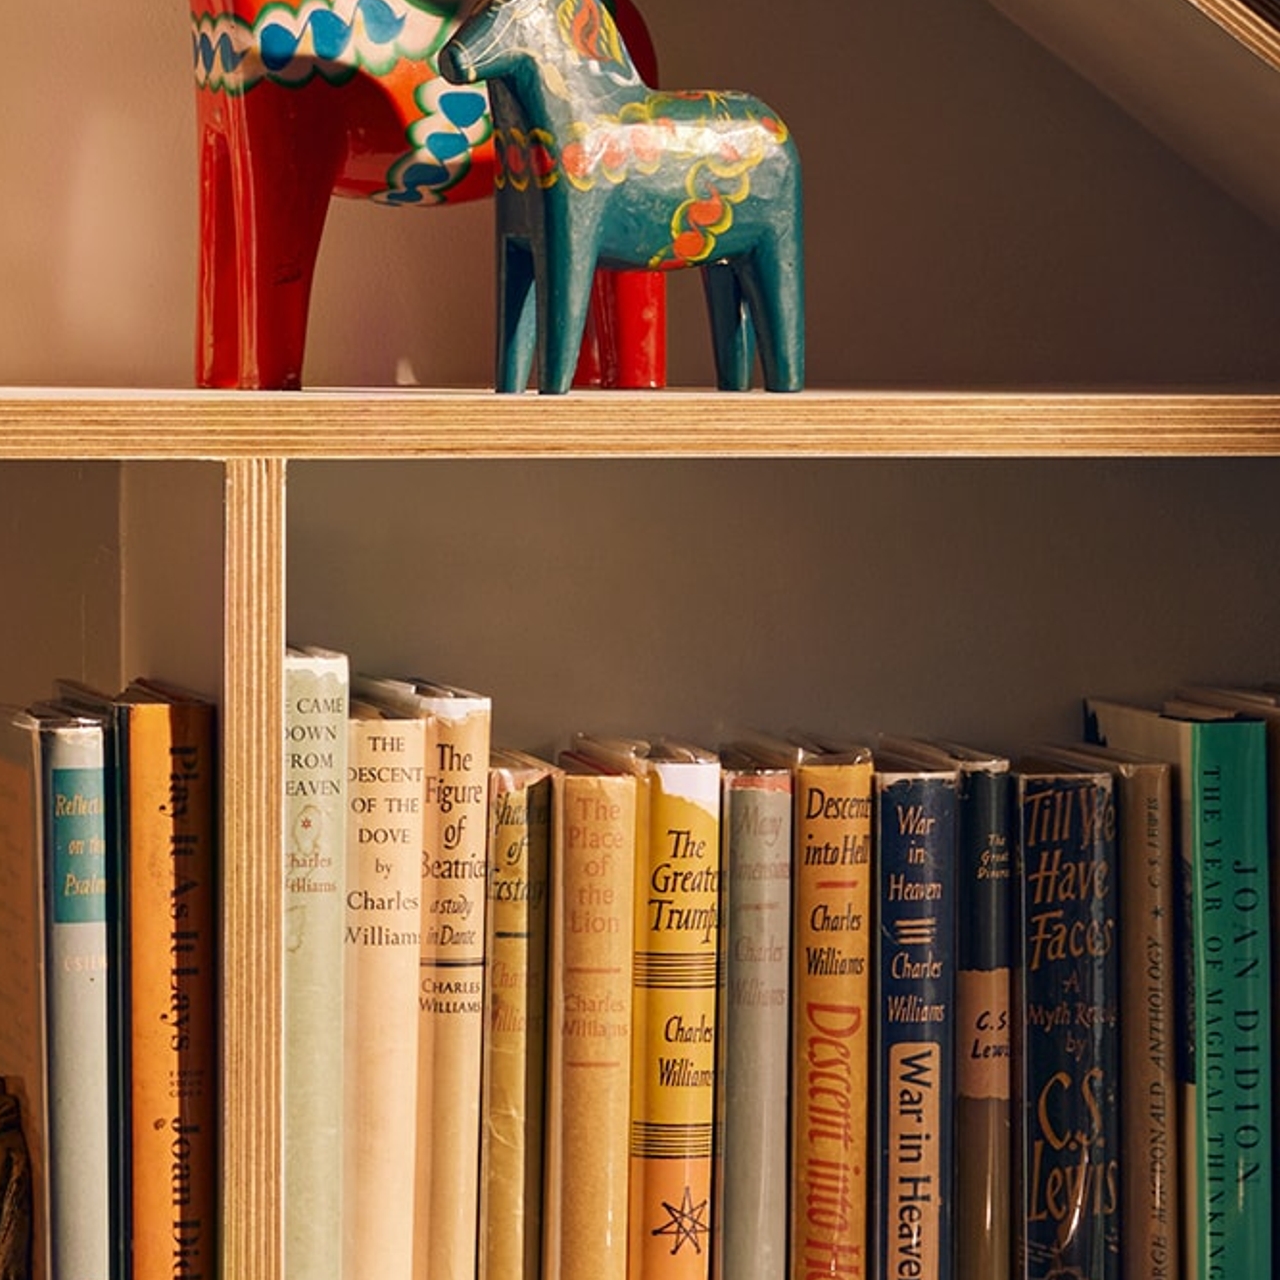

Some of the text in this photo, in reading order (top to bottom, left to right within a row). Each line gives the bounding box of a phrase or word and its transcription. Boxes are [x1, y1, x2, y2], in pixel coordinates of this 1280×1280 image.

[296, 698, 343, 715] CAME
[367, 736, 406, 754] THE
[436, 743, 473, 771] The
[347, 766, 424, 784] DESCENT
[350, 796, 420, 814] OF THE
[425, 775, 483, 814] Figure
[806, 786, 872, 821] Descent
[1203, 764, 1223, 823] THE
[577, 797, 621, 821] The
[897, 803, 936, 836] War
[1025, 784, 1118, 851] Till We
[358, 827, 411, 844] DOVE
[444, 816, 468, 850] of
[568, 826, 624, 851] Place
[667, 829, 706, 859] The
[804, 833, 839, 866] into
[840, 833, 872, 866] Hell
[908, 840, 927, 864] in
[375, 858, 394, 879] by
[584, 854, 612, 878] of
[1029, 851, 1110, 905] Have
[1203, 836, 1223, 914] YEAR
[346, 889, 420, 911] Charles
[578, 884, 615, 905] the
[888, 875, 942, 901] Heaven
[440, 895, 475, 922] study
[570, 909, 620, 935] Lion
[810, 902, 862, 933] Charles
[441, 924, 477, 947] Dante
[1029, 910, 1114, 971] Faces
[805, 946, 865, 977] Williams
[891, 950, 942, 980] Charles
[1204, 936, 1224, 973] OF
[421, 979, 481, 995] CHARLES
[418, 998, 482, 1014] WILLIAMS
[566, 991, 625, 1015] Charles
[888, 994, 946, 1023] Williams
[563, 1017, 628, 1040] Williams
[663, 1014, 714, 1045] Charles
[1231, 860, 1262, 1185] JOAN DIDION
[1205, 988, 1225, 1119] MAGICAL
[806, 1001, 863, 1149] Descent
[899, 1049, 934, 1124] War
[154, 1116, 201, 1207] Joan
[899, 1132, 932, 1164] in
[1027, 1138, 1119, 1221] Lewis
[806, 1158, 863, 1234] into
